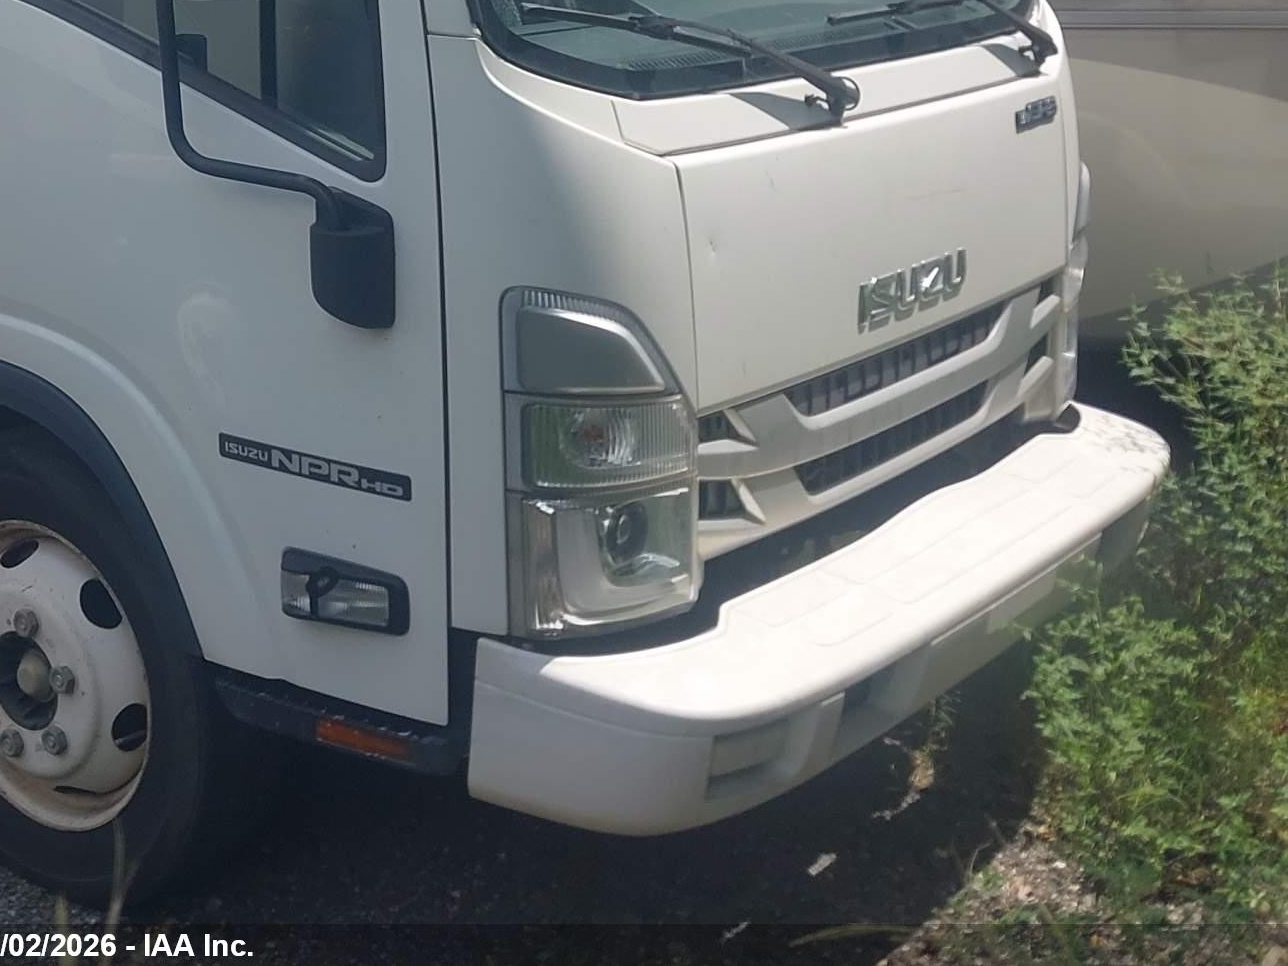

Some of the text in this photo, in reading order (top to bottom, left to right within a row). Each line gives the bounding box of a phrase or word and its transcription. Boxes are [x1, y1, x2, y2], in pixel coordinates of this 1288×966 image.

[857, 247, 967, 328] ISUZU
[225, 441, 404, 497] ISUZU NPR HD
